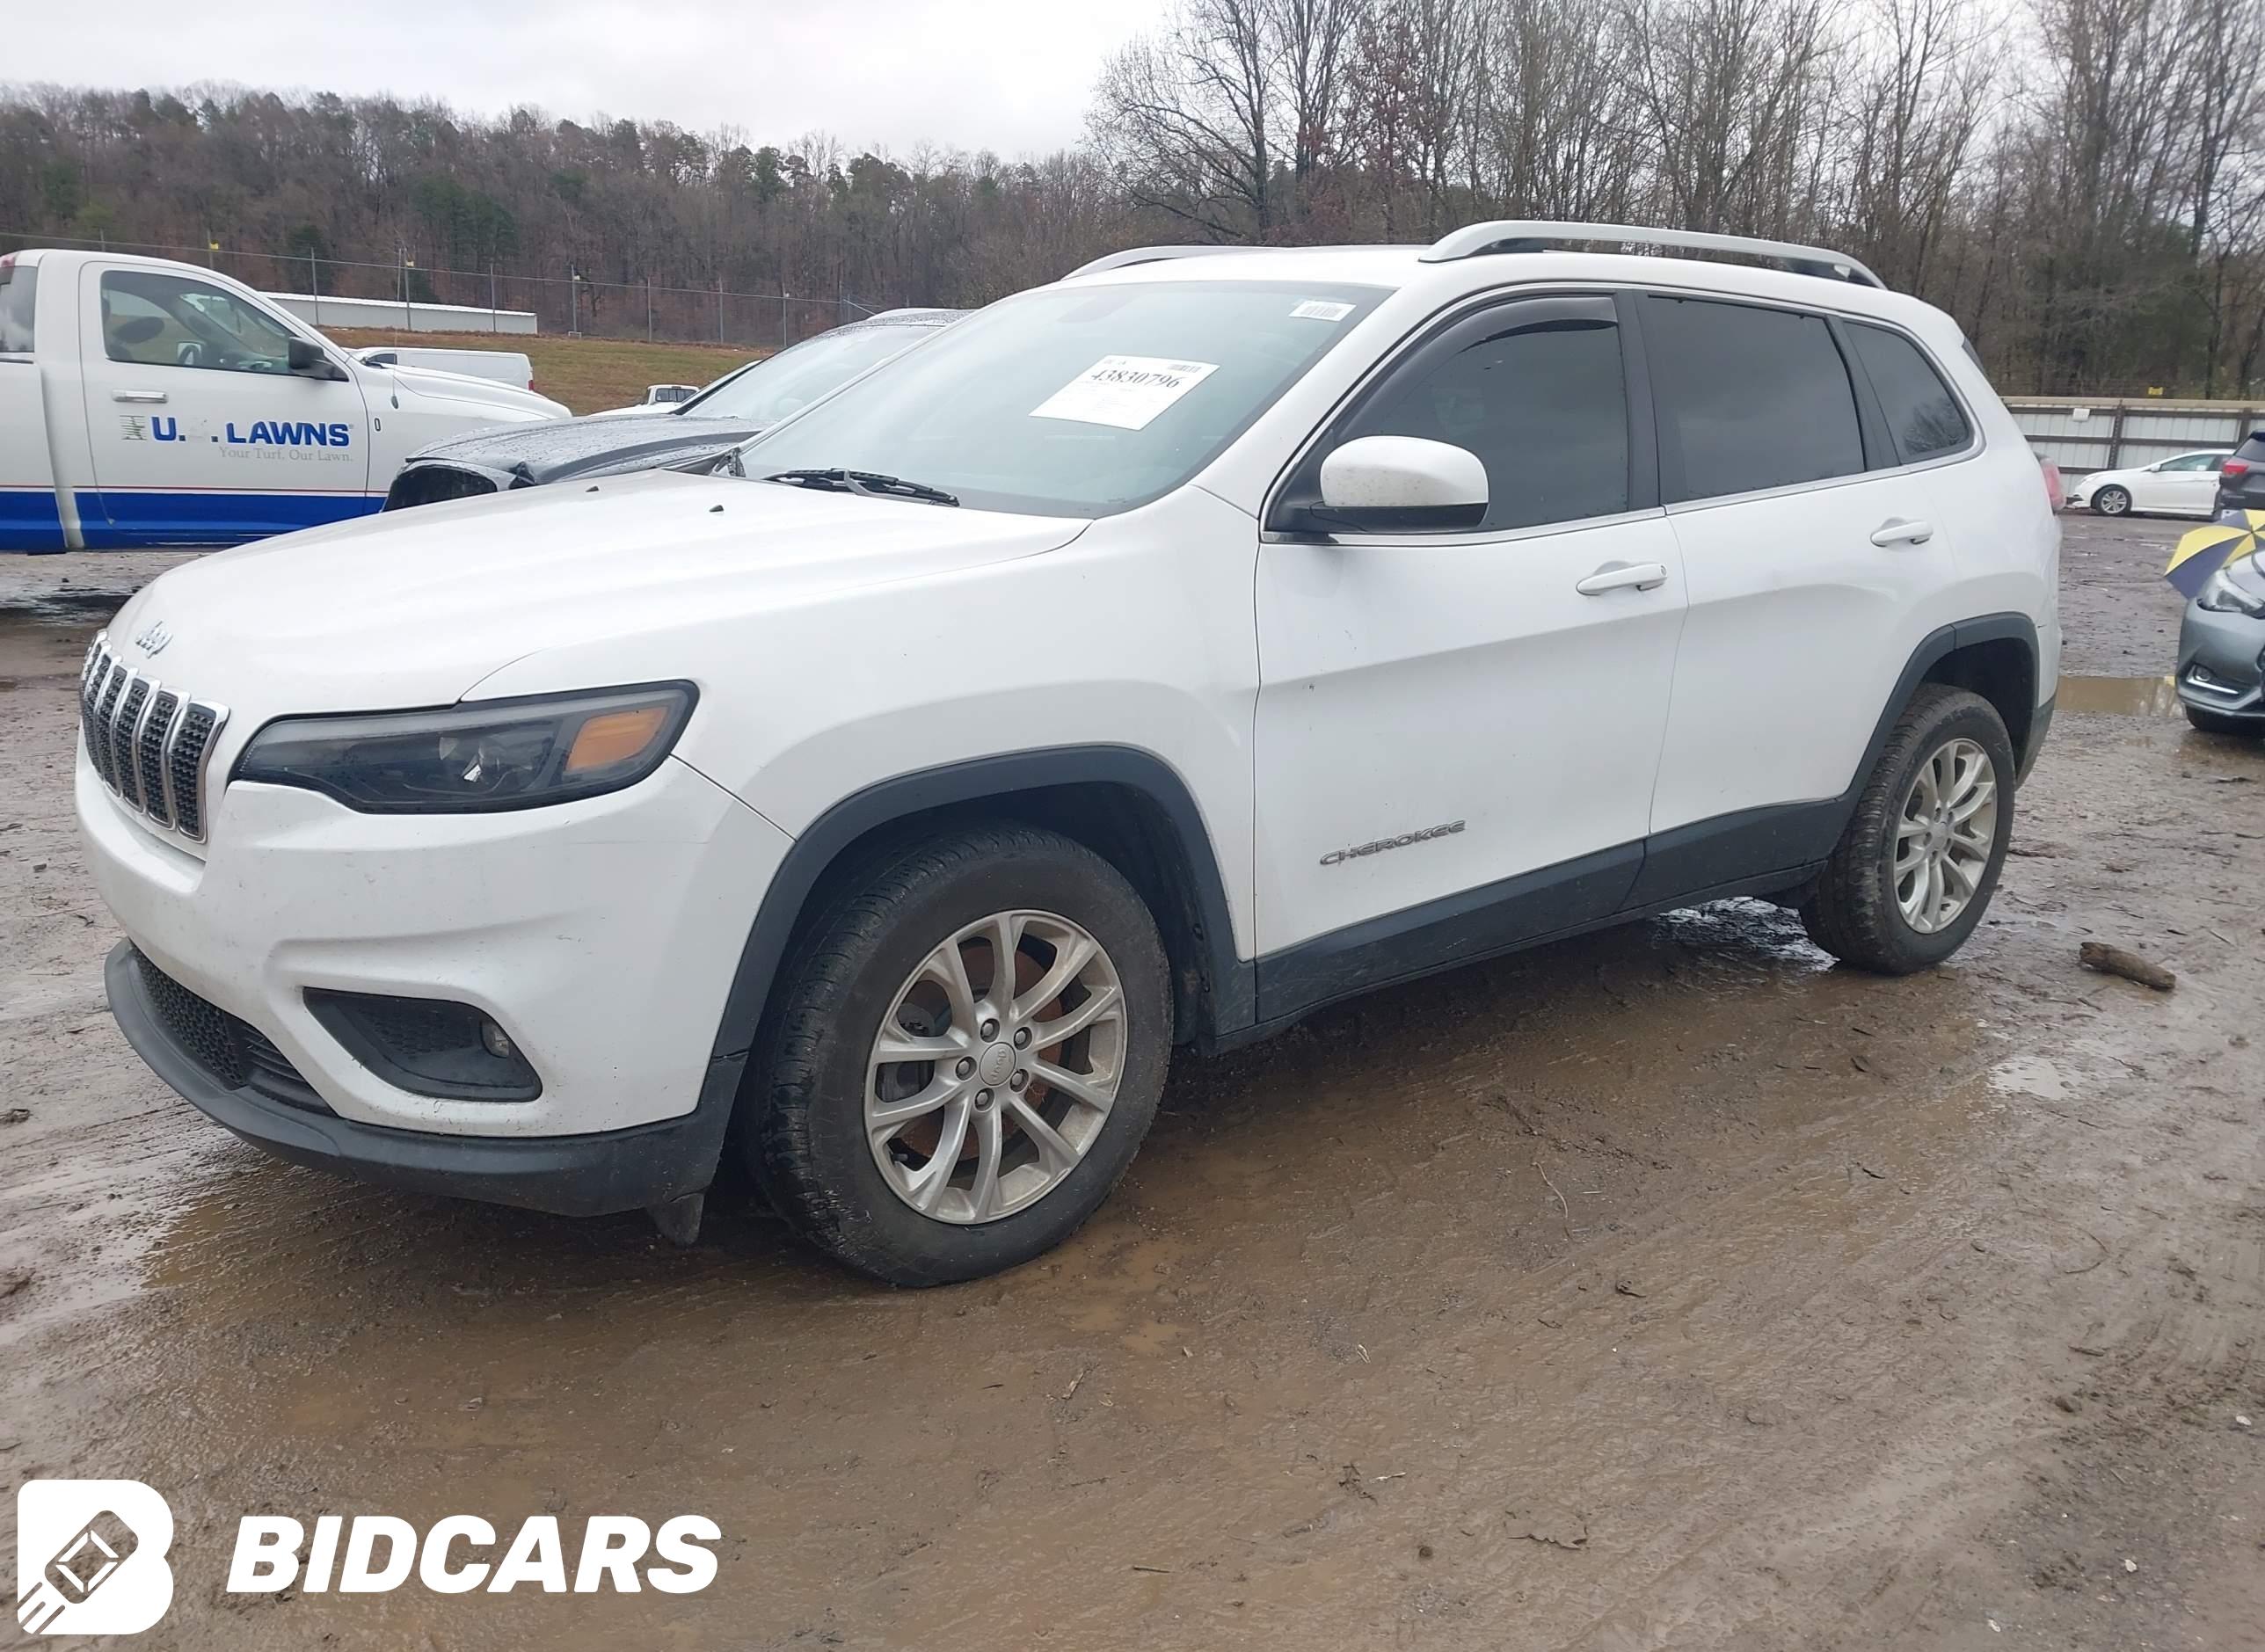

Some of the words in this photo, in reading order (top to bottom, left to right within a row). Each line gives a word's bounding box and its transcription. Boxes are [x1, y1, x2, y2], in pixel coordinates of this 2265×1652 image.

[1091, 369, 1185, 389] 43830796
[226, 421, 350, 447] LAWNS
[220, 446, 250, 459] Your
[256, 448, 285, 461] Turf.
[288, 449, 313, 461] Our
[317, 449, 353, 462] Lawn.
[1319, 819, 1466, 866] CHEROKEE
